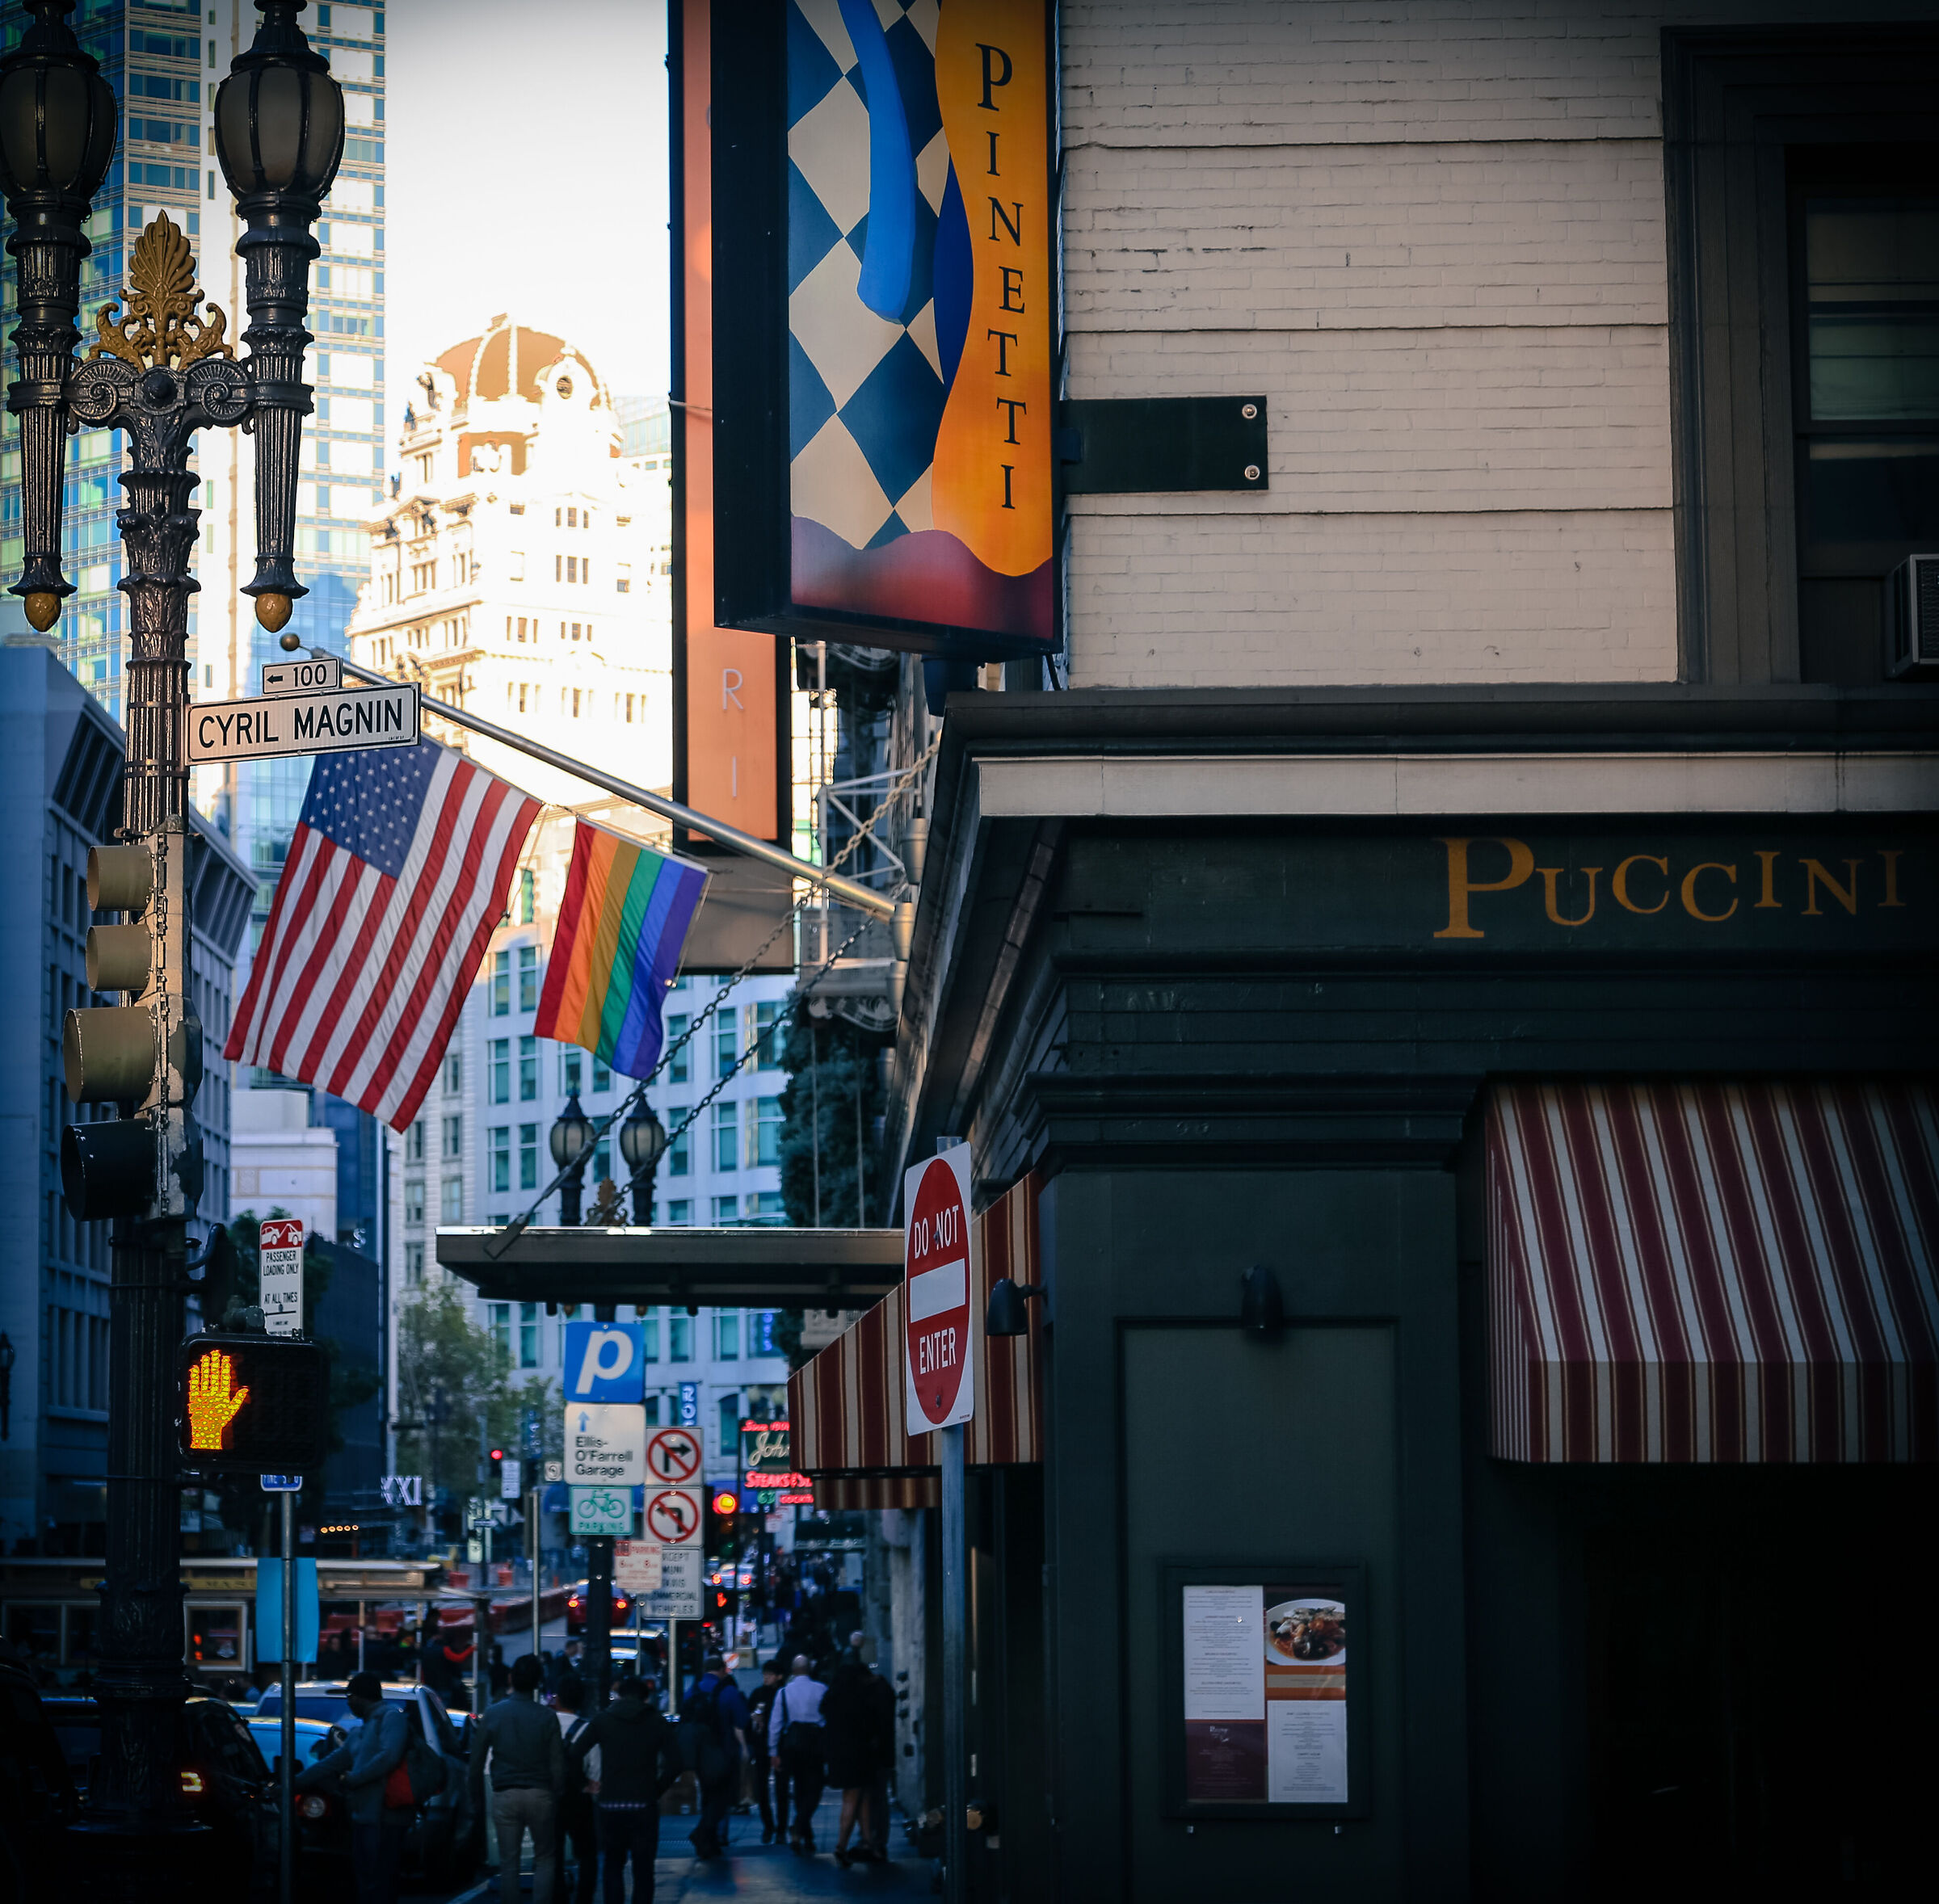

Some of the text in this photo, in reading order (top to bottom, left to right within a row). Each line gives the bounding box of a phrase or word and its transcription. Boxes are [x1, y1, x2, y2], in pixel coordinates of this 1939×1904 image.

[975, 43, 1027, 509] PINETTI
[292, 665, 327, 687] 100
[199, 699, 402, 748] CYRIL MAGNIN
[1433, 837, 1907, 939] PUCCINI
[915, 1205, 959, 1259] DO NOT
[266, 1250, 297, 1263] PASSENGER
[263, 1263, 299, 1276] LOADING ONLY
[264, 1292, 298, 1304] AT ALL TIMES
[919, 1327, 956, 1374] ENTER
[575, 1436, 608, 1448] Ellis-
[575, 1448, 633, 1462] O'Farrell
[575, 1464, 624, 1478] Garage
[578, 1522, 625, 1532] PARKING
